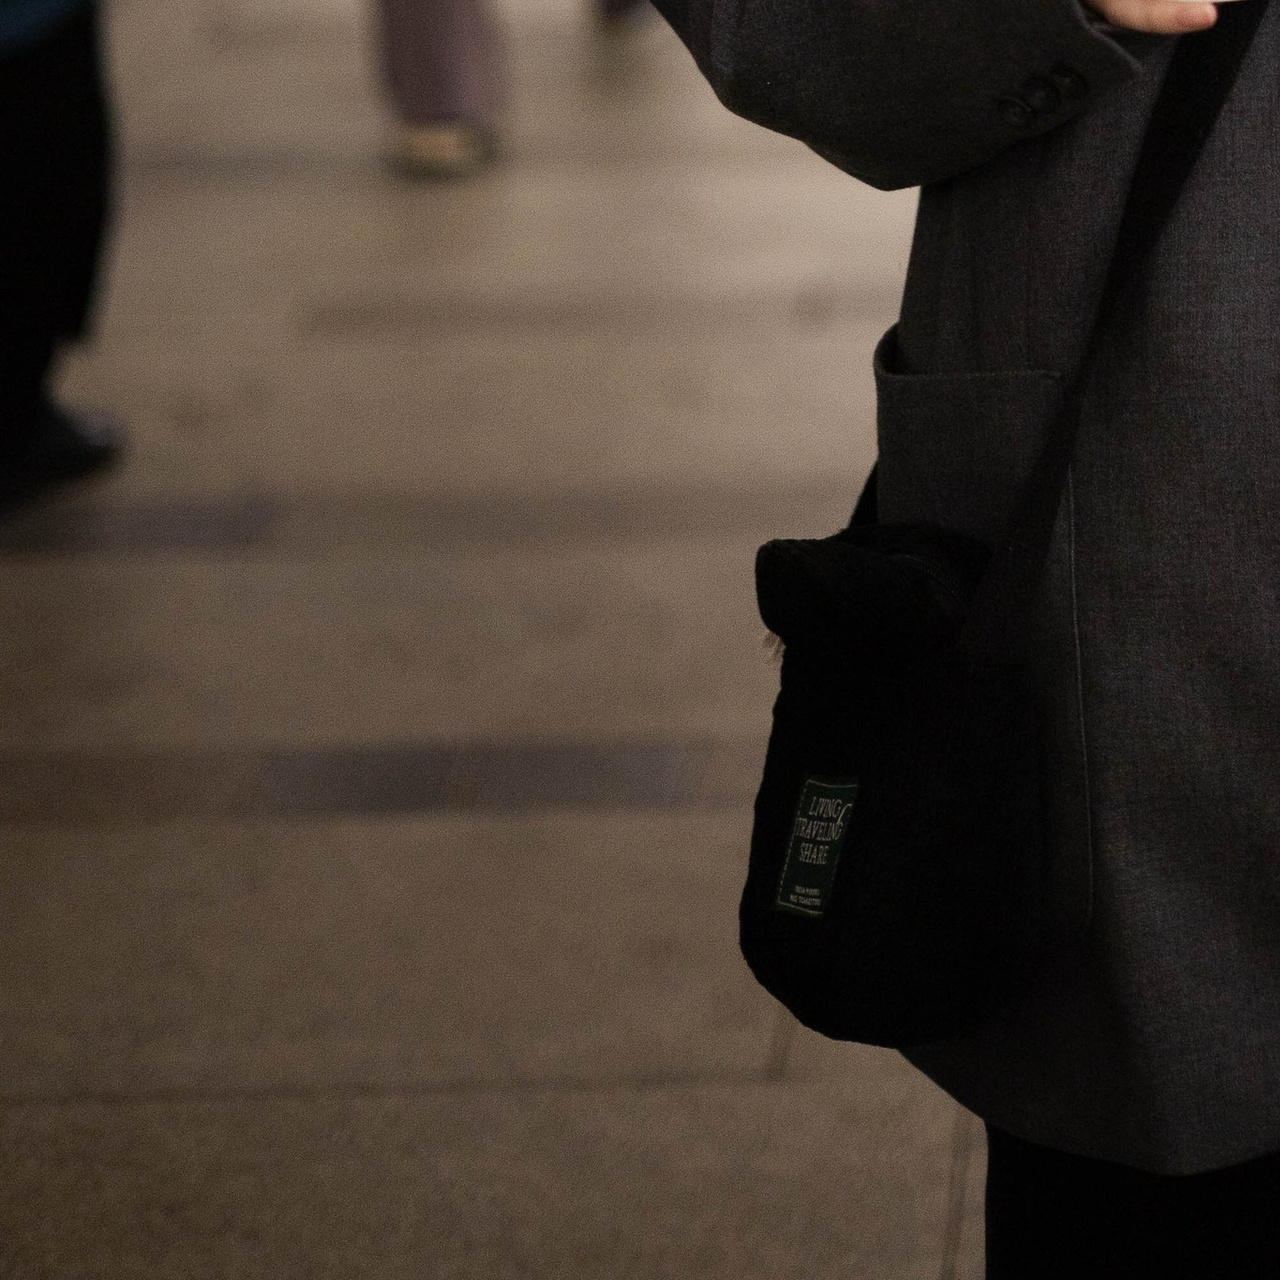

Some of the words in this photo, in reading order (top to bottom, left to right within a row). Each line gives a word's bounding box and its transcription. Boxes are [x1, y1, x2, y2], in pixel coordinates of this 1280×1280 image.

[809, 796, 842, 818] LIVING
[797, 817, 844, 841] TRAVELING
[799, 842, 830, 864] SHARE
